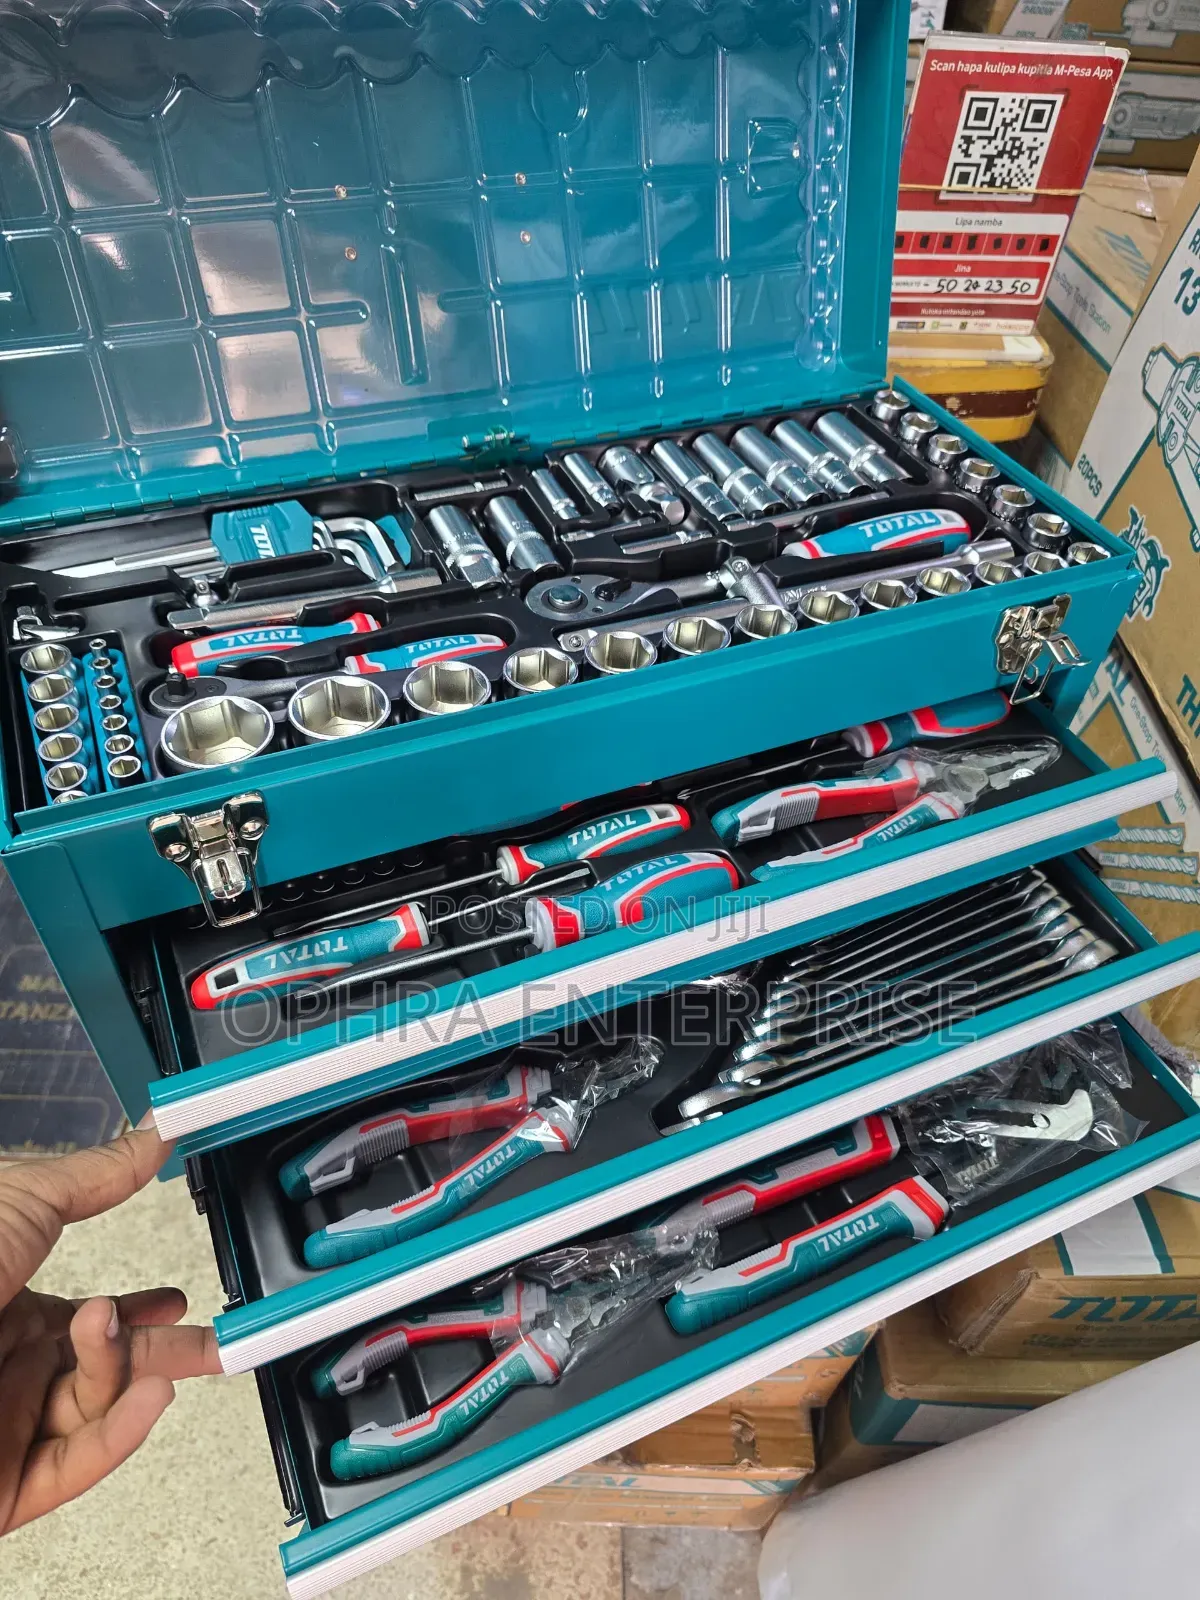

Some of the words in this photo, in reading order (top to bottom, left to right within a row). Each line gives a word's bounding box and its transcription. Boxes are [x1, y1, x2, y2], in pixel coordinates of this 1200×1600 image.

[930, 59, 956, 72] Scan
[957, 62, 982, 77] hapa
[983, 62, 1016, 76] kulipa
[1017, 63, 1052, 77] kupitia
[1054, 65, 1091, 77] M-Pesa
[1092, 66, 1113, 80] App
[955, 217, 974, 228] Lipa
[974, 218, 1003, 228] namba
[954, 263, 972, 273] Jina
[933, 278, 958, 294] 50
[984, 280, 1003, 293] 23
[1006, 280, 1031, 295] 50
[1174, 395, 1191, 421] TOTAL
[1078, 453, 1103, 497] 20PCS
[858, 512, 937, 538] TOTAL
[222, 629, 302, 648] TOTAL
[405, 636, 471, 653] TOTAL
[1129, 696, 1153, 744] One-Stop
[567, 813, 637, 846] TOTAL
[877, 815, 918, 842] TOTAL
[600, 853, 679, 891] TOTAL
[264, 936, 349, 969] TOTAL
[463, 1143, 516, 1186] TOTAL
[817, 1213, 880, 1251] TOTAL
[459, 1370, 509, 1416] TOTAL
